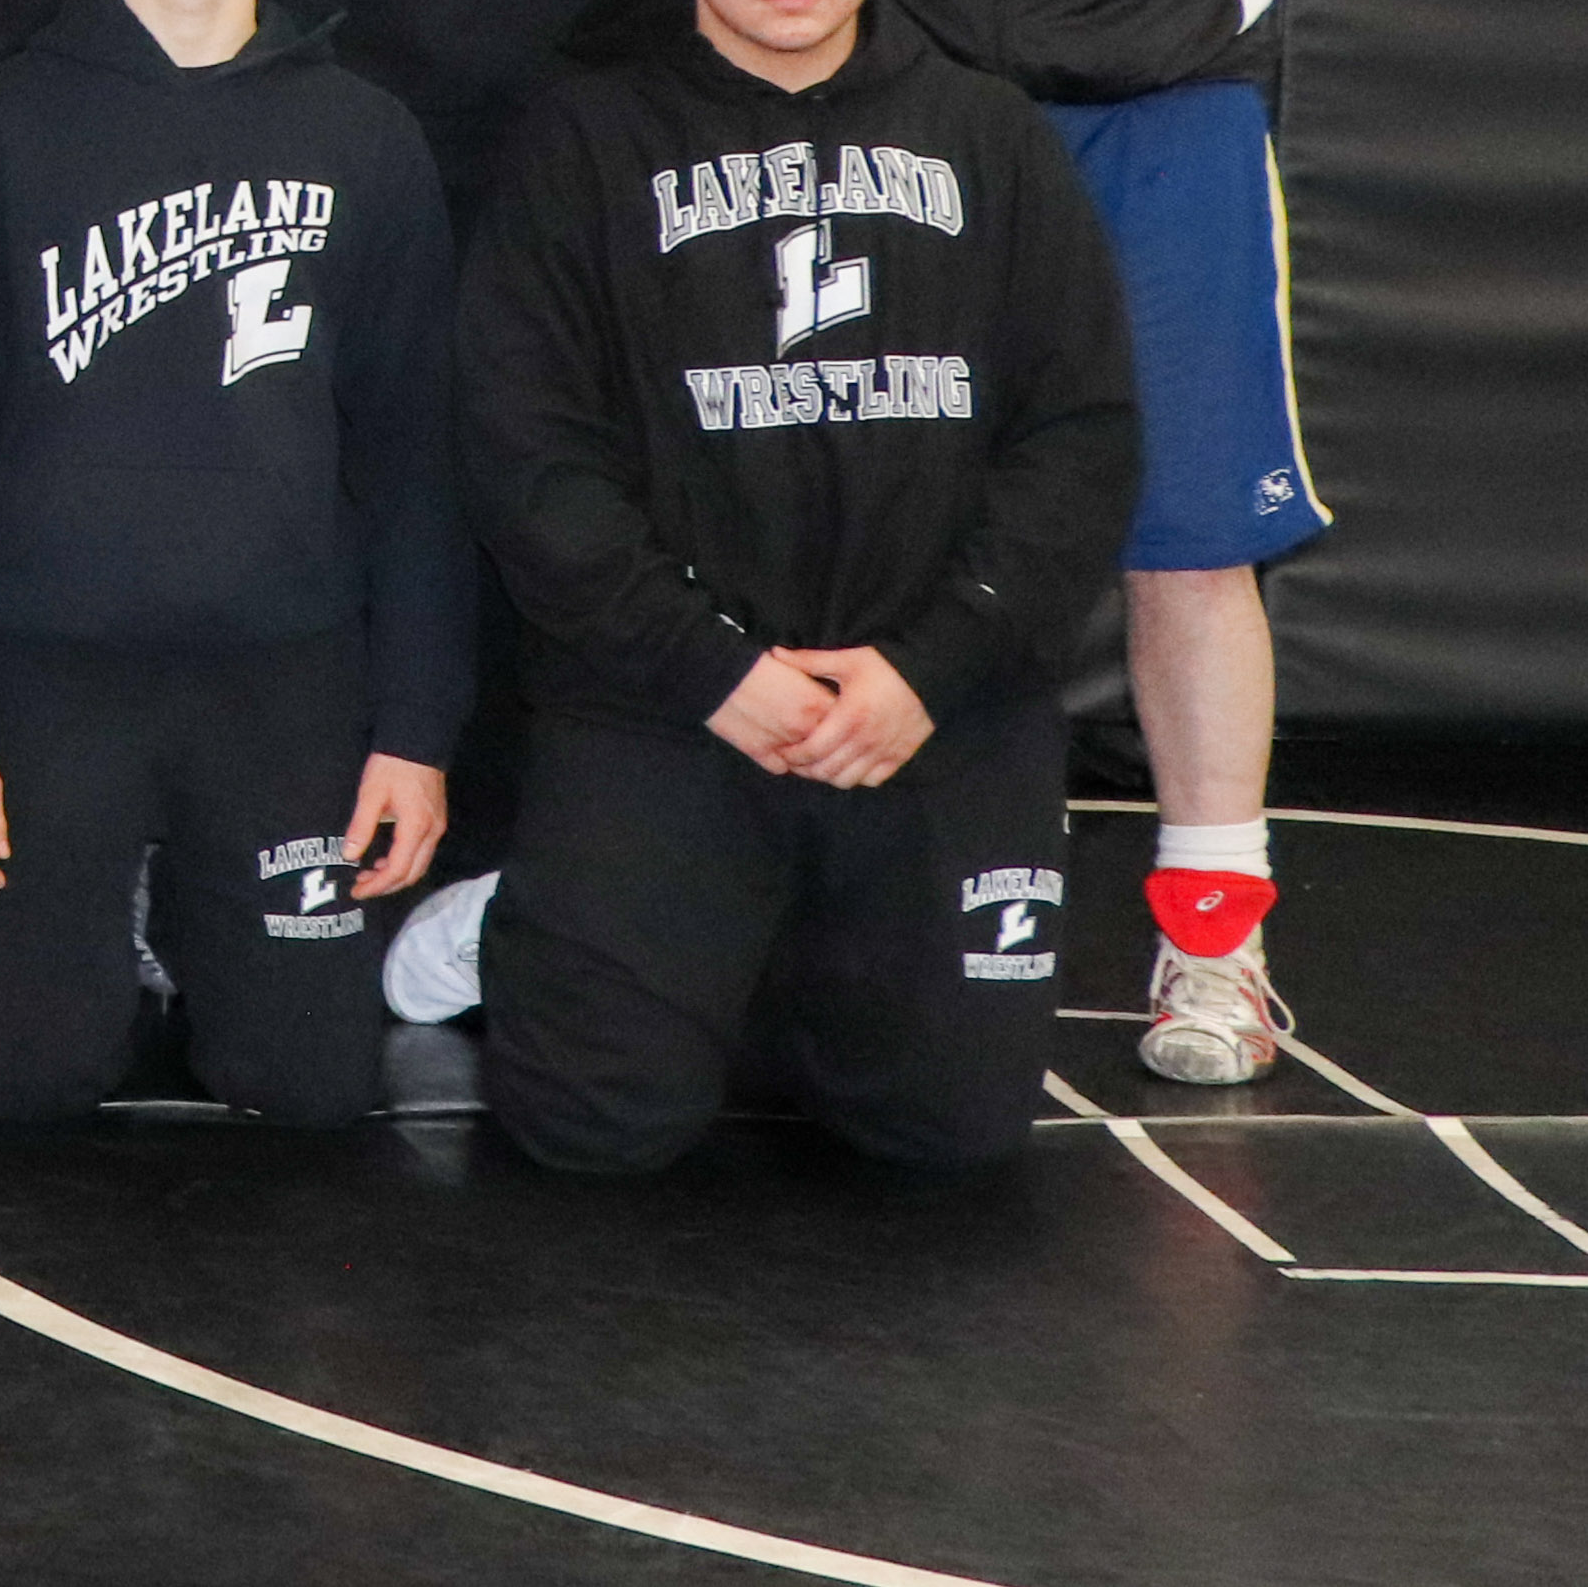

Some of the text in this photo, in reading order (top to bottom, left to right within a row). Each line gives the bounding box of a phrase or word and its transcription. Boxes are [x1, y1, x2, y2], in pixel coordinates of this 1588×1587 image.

[652, 140, 964, 253] LAKELAND
[41, 179, 334, 340] LAKELAND
[48, 227, 327, 384] WRESTLING
[685, 355, 973, 431] WRESTLING
[258, 836, 360, 880] LAKELA
